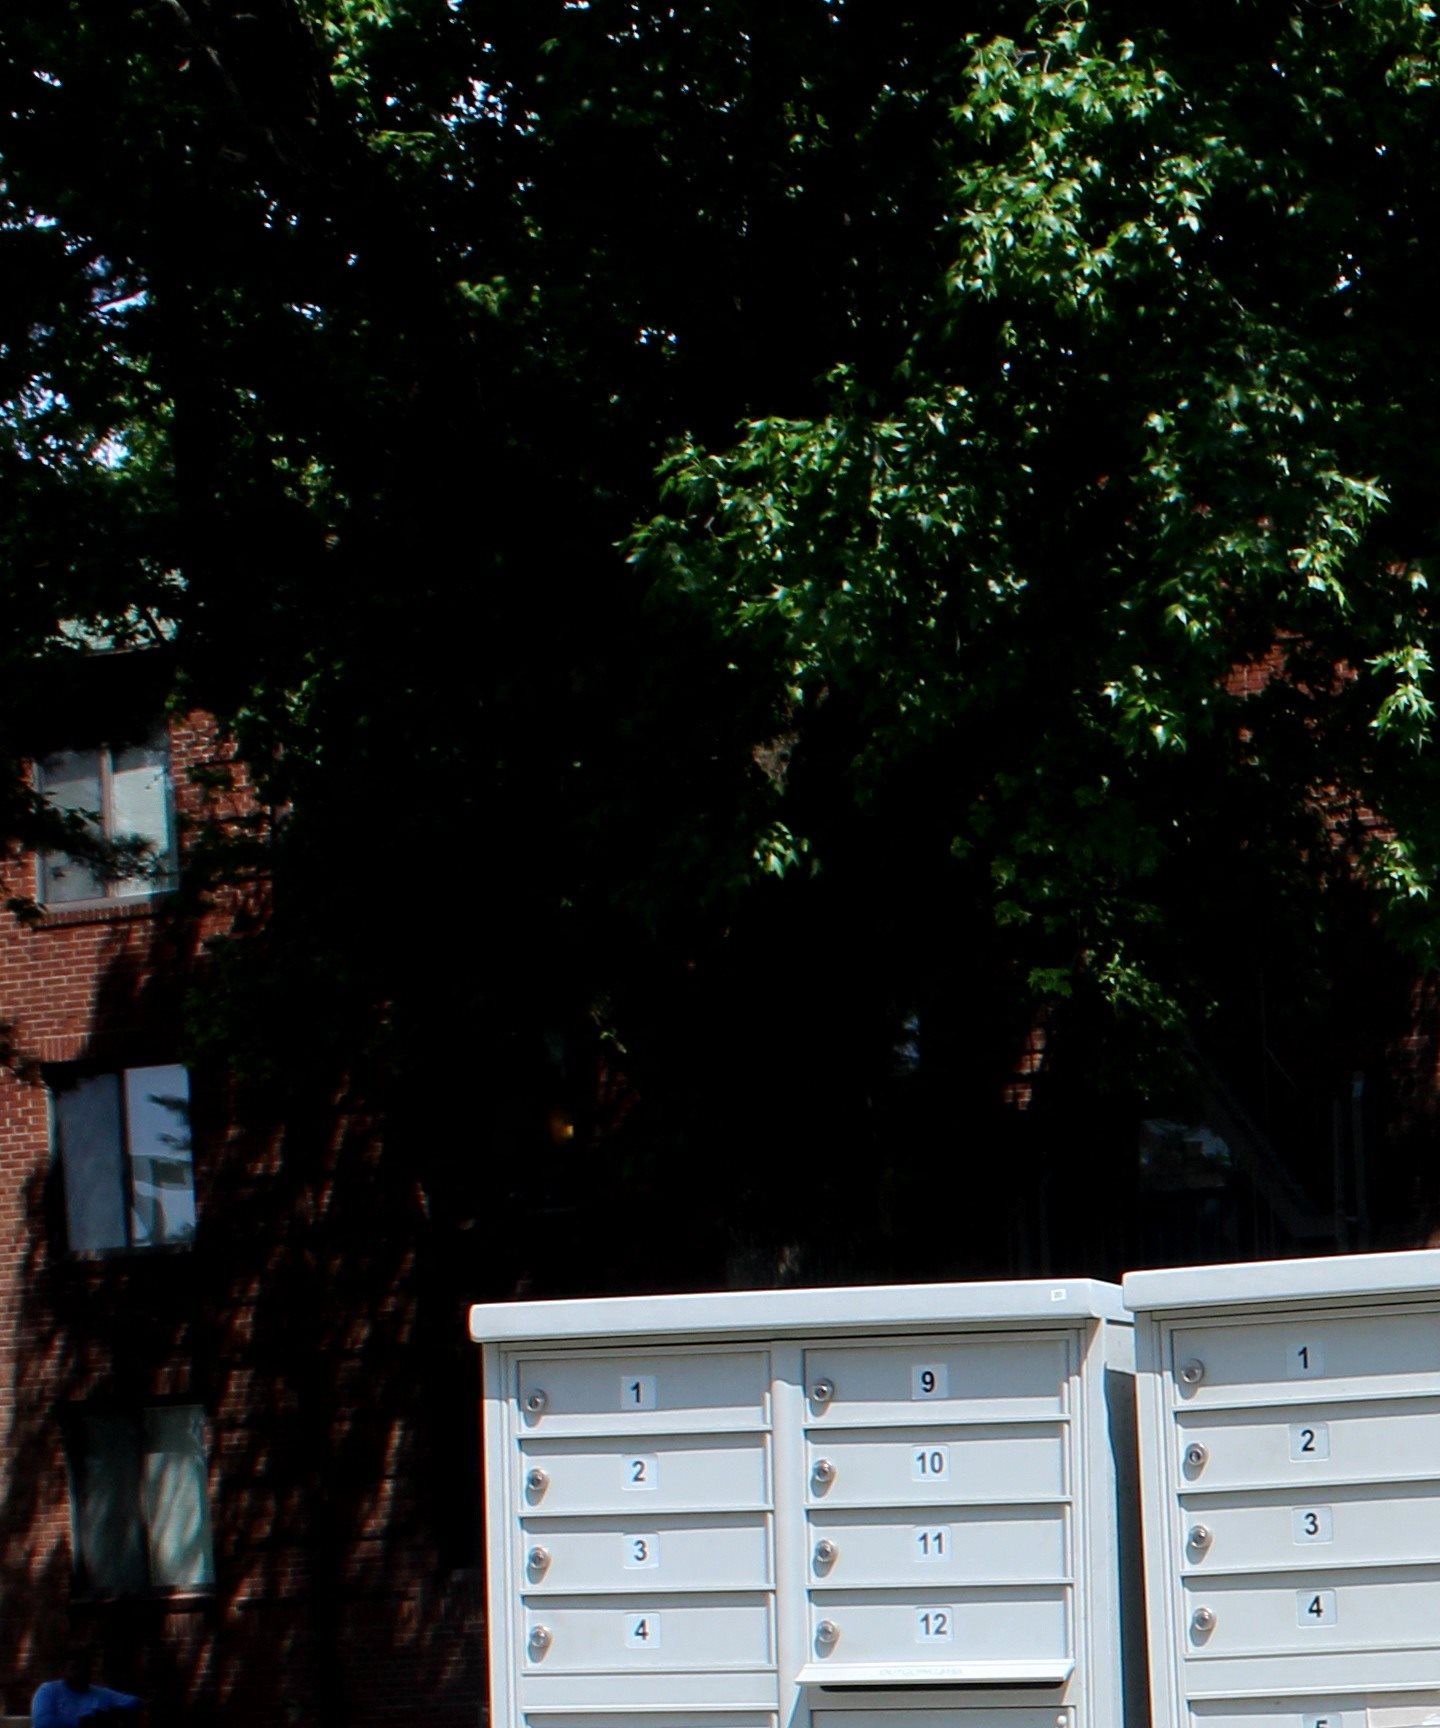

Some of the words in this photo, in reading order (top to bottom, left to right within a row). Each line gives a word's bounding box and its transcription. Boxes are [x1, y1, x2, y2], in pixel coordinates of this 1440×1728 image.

[1298, 1346, 1308, 1369] 1
[631, 1381, 641, 1403] 1
[921, 1370, 935, 1393] 9
[1301, 1429, 1315, 1452] 2
[632, 1460, 645, 1482] 2
[915, 1451, 944, 1474] 10
[1305, 1512, 1319, 1536] 3
[634, 1539, 647, 1562] 3
[918, 1532, 943, 1555] 11
[1308, 1595, 1323, 1618] 4
[634, 1619, 648, 1640] 4
[919, 1613, 947, 1635] 12
